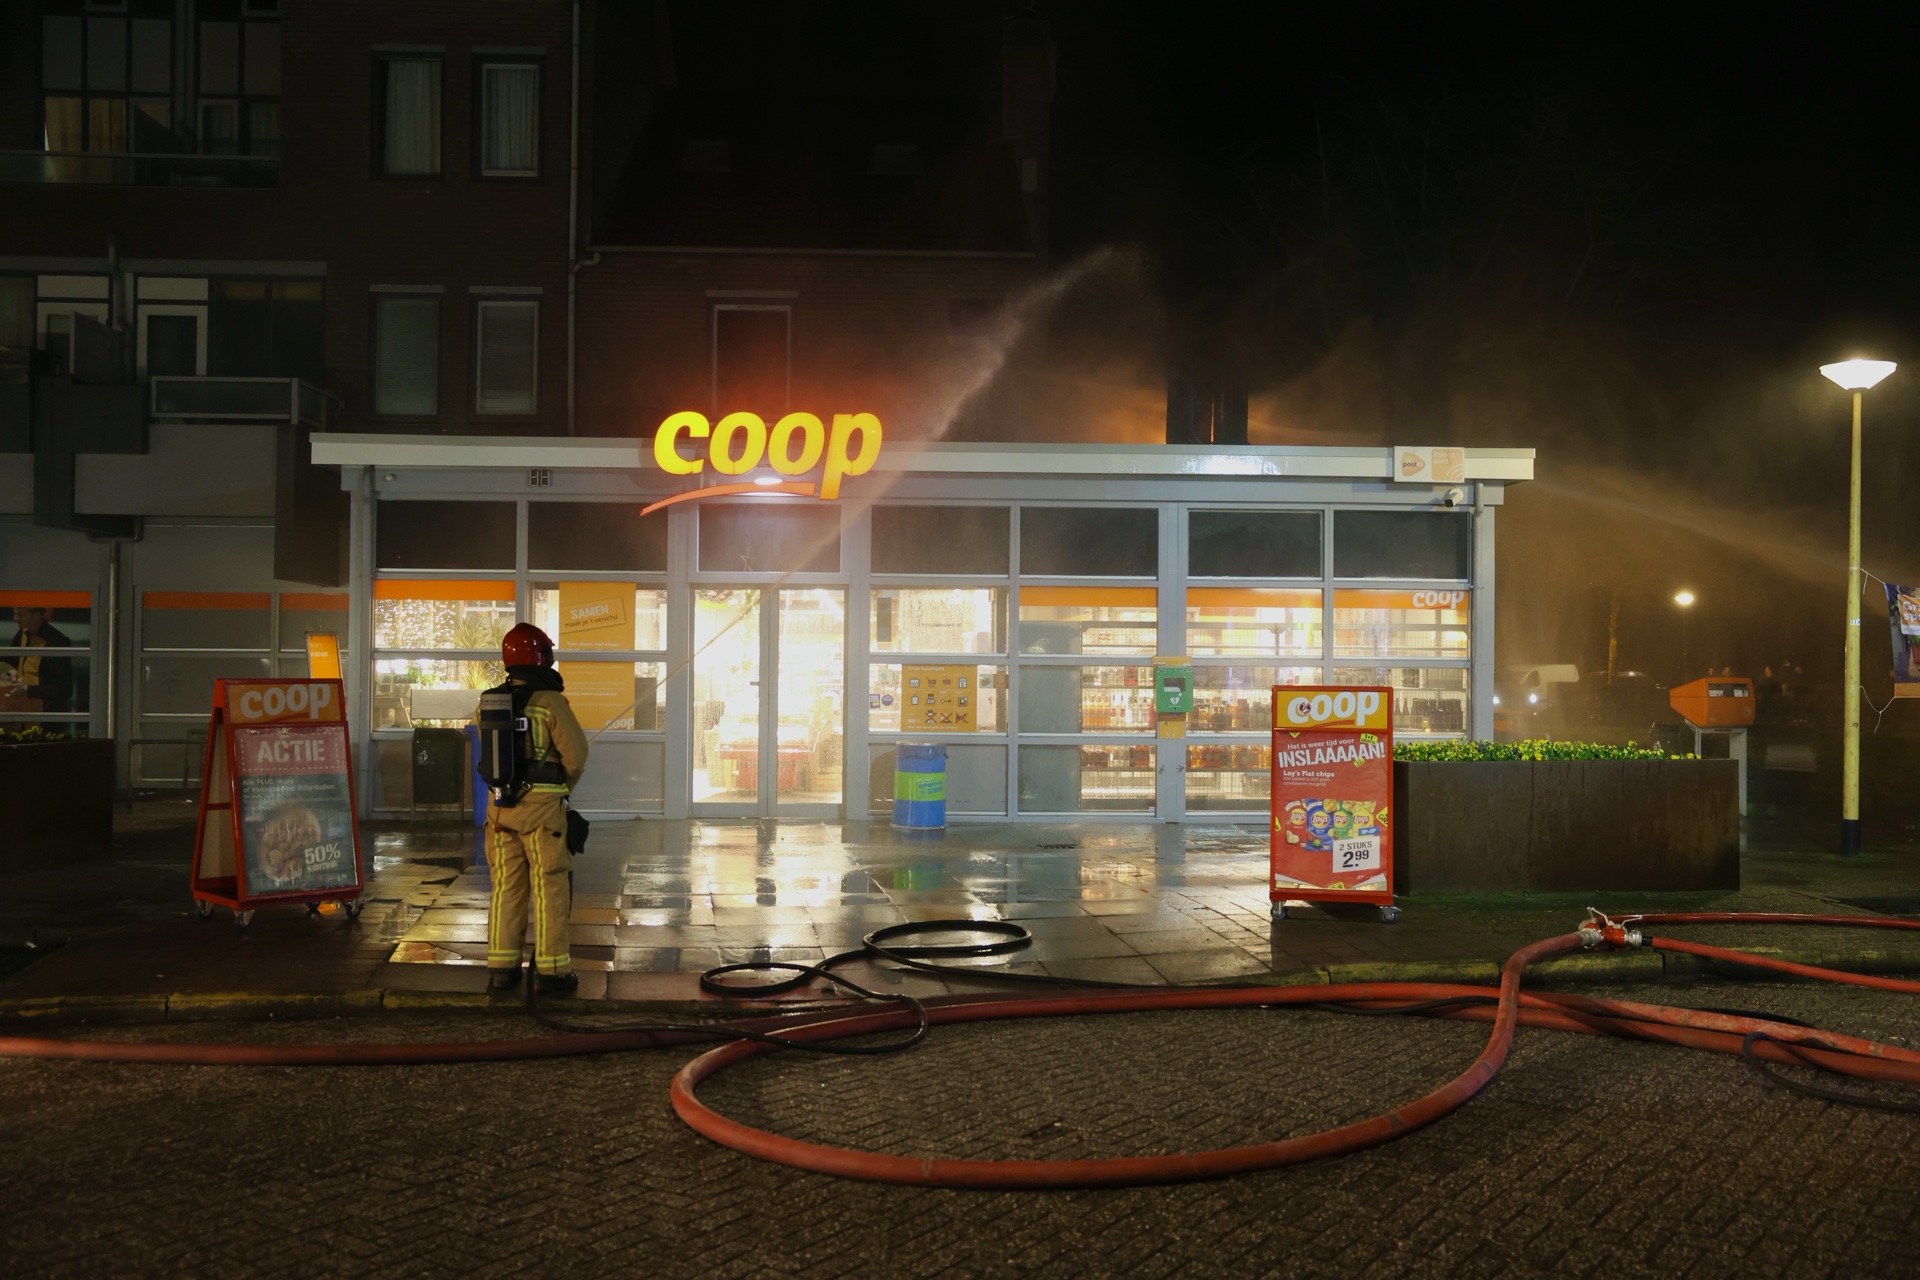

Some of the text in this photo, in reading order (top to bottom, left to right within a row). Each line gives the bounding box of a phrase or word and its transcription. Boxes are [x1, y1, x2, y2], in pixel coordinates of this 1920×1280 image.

[654, 411, 883, 500] coop
[1412, 590, 1464, 609] coop
[1902, 601, 1920, 611] Gr
[570, 604, 610, 620] SAMEN
[1903, 612, 1920, 623] sp
[564, 620, 582, 628] maak
[582, 619, 589, 627] je
[240, 683, 331, 720] coop
[1287, 691, 1380, 727] coop
[257, 738, 325, 763] ACTIE
[1308, 741, 1324, 749] weer
[1326, 739, 1338, 747] tijd
[1278, 742, 1385, 768] INSLAAAAAN!
[1283, 769, 1301, 777] Lay's
[1316, 770, 1335, 779] chips
[304, 842, 341, 865] 50%
[1339, 841, 1373, 851] 2 STUKS
[307, 860, 338, 873] KORTING
